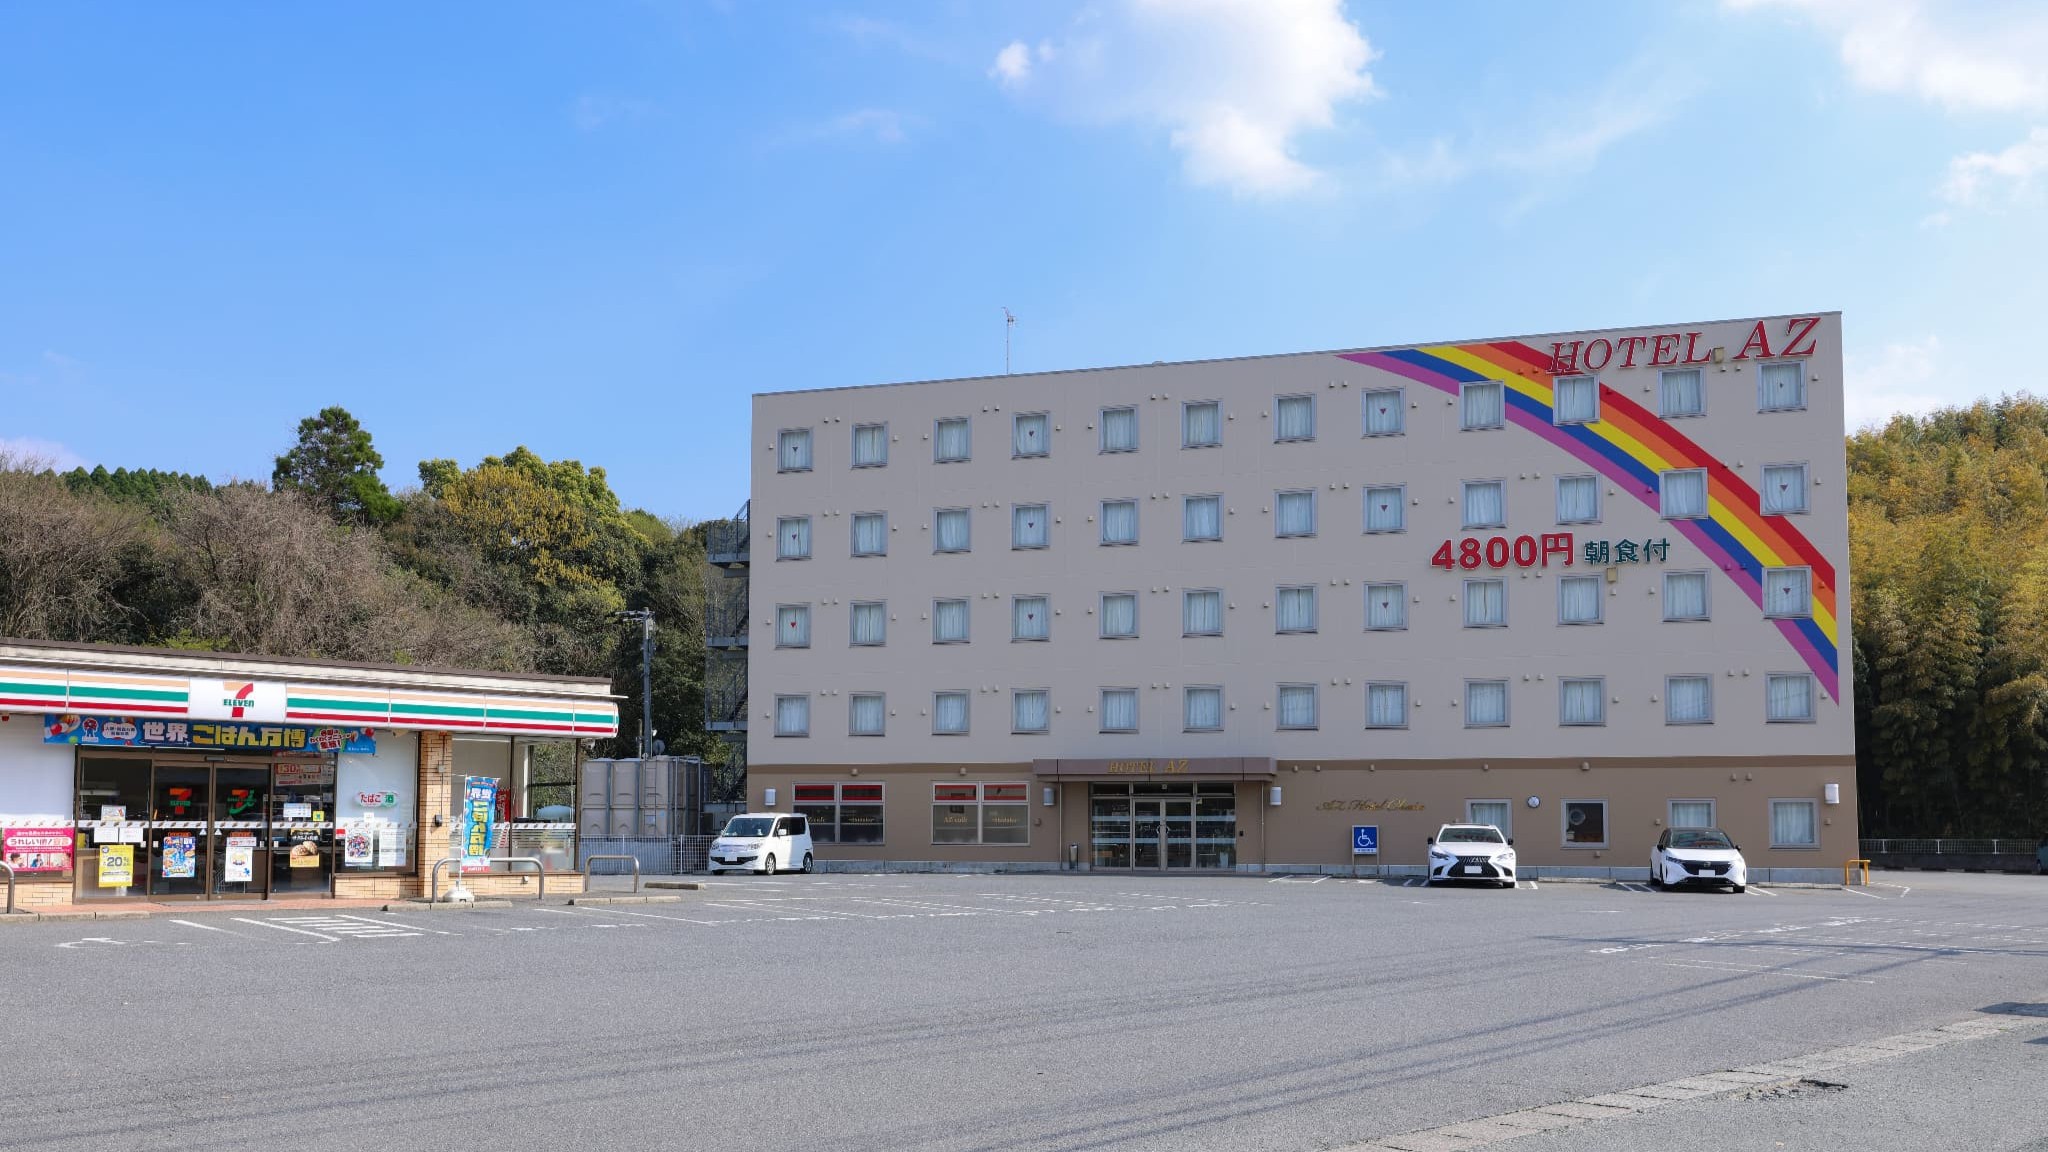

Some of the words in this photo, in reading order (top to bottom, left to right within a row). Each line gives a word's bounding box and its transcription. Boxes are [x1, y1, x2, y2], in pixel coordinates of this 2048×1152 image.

[1546, 331, 1713, 375] HOTEL
[1732, 317, 1821, 361] AZ
[1430, 532, 1575, 570] 4800円
[1584, 537, 1671, 565] 朝食付
[142, 721, 188, 742] 世界
[192, 723, 306, 748] ごはん万博
[1108, 760, 1155, 773] HOTEL
[1165, 758, 1189, 773] AZ
[360, 794, 381, 803] たばこ
